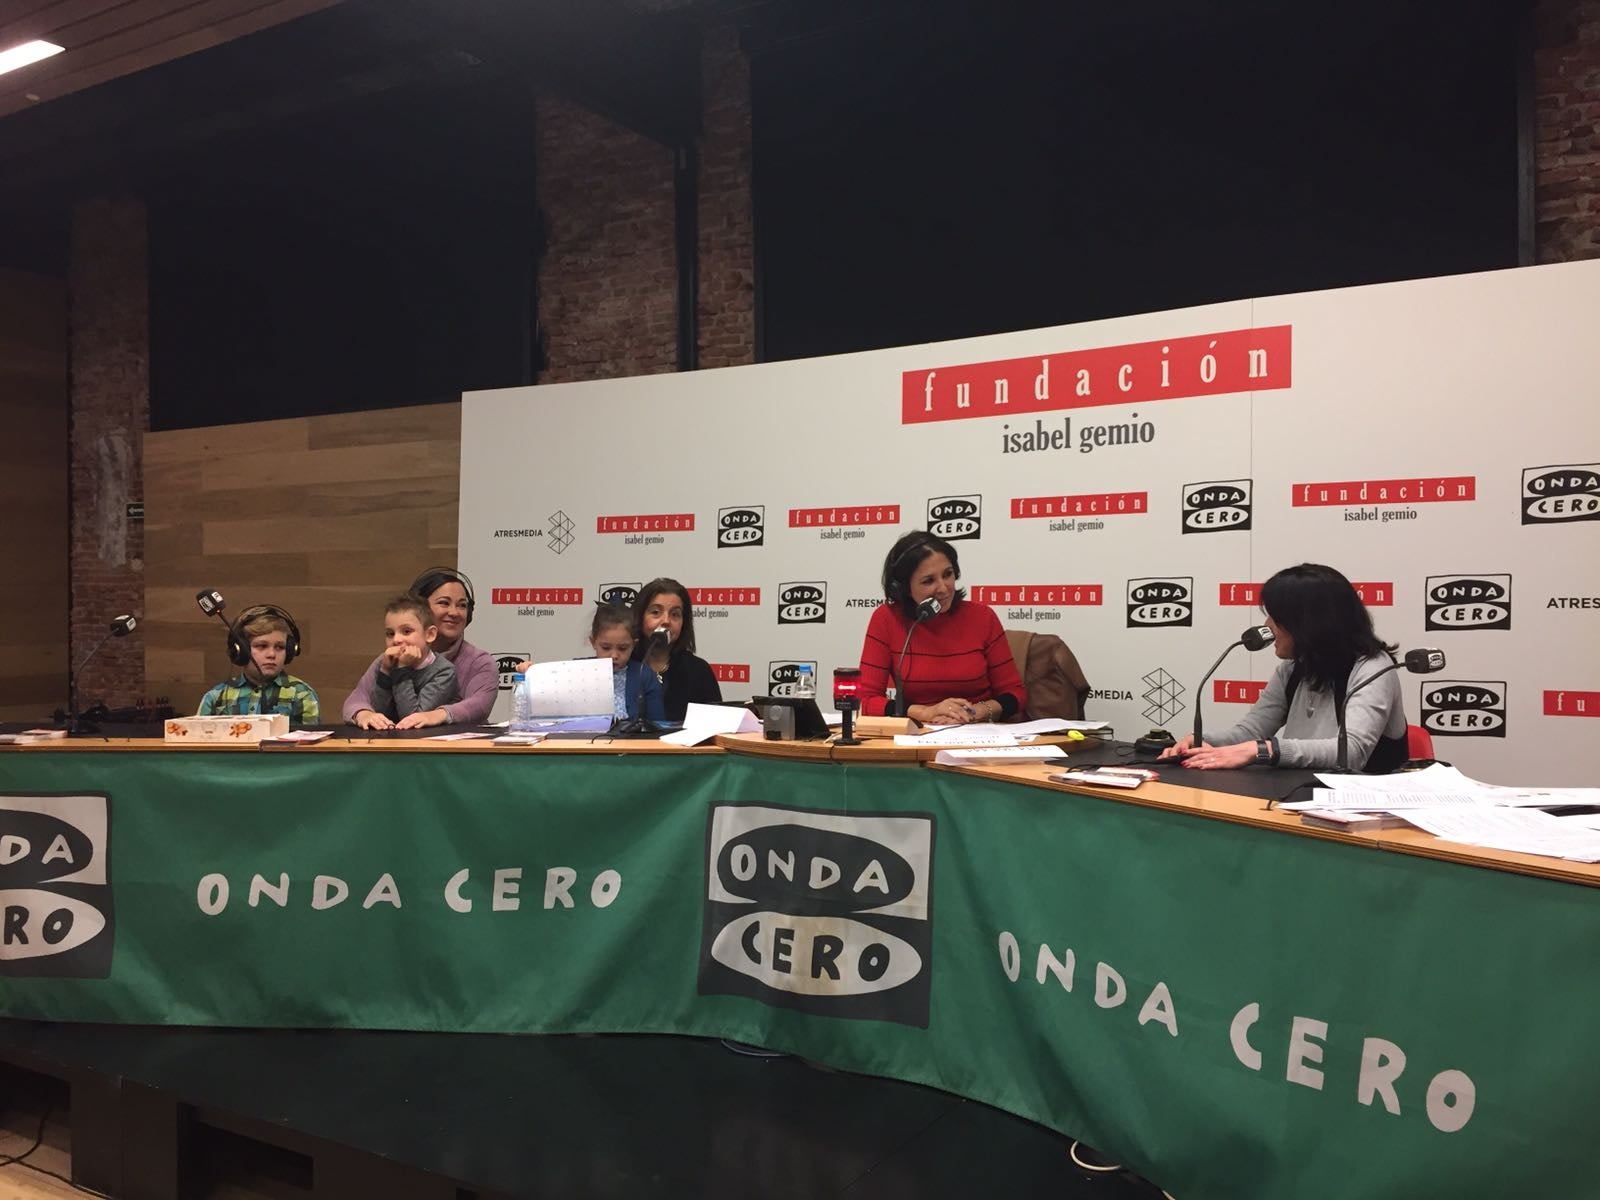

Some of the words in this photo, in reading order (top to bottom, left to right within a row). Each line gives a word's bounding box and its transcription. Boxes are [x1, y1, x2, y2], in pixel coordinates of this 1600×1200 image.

[925, 341, 1268, 411] fundación
[1003, 417, 1071, 453] isabel
[1079, 413, 1155, 453] gemio
[1534, 476, 1598, 491] ONDA
[1191, 490, 1241, 504] ONDA
[1303, 479, 1466, 502] fundación
[934, 505, 974, 515] ONDA
[1019, 495, 1141, 515] fundación
[1538, 499, 1599, 513] CERO
[724, 515, 758, 525] ONDA
[795, 508, 895, 524] fundación
[1194, 510, 1241, 524] CERO
[1344, 507, 1378, 521] isabel
[1381, 508, 1417, 523] gemio
[602, 515, 691, 531] fundación
[936, 522, 973, 533] CERO
[1049, 519, 1075, 532] isabel
[1077, 519, 1104, 532] gemio
[494, 529, 543, 538] ATRESMEDIA
[624, 535, 643, 544] isabel
[644, 535, 664, 545] gemio
[726, 531, 757, 541] CERO
[820, 529, 841, 539] isabel
[843, 529, 865, 540] gemio
[498, 589, 579, 602] fundación
[604, 591, 635, 600] ODA
[696, 588, 756, 602] dación
[784, 590, 819, 600] ONDA
[979, 586, 1096, 602] fundación
[1136, 588, 1183, 599] ONDA
[1437, 586, 1498, 599] ONDA
[1547, 597, 1600, 609] ATRES
[517, 606, 535, 616] isabel
[536, 607, 554, 617] gemio
[708, 607, 729, 619] gemio
[786, 607, 819, 617] CERO
[1008, 608, 1033, 620] isabel
[1034, 608, 1061, 621] gemio
[1138, 607, 1183, 619] CERO
[1440, 608, 1498, 621] CERO
[775, 669, 801, 679] OND
[1087, 689, 1134, 701] SMEDIA
[1432, 692, 1493, 704] ONDA
[1435, 713, 1493, 727] CERO
[0, 834, 75, 866] DA
[730, 844, 890, 895] ONDA
[197, 871, 402, 916] ONDA
[444, 866, 622, 914] CERO
[3, 905, 75, 945] RO
[741, 920, 891, 982] CERO
[998, 931, 1179, 1037] ONDA
[1230, 1002, 1476, 1133] CERO
